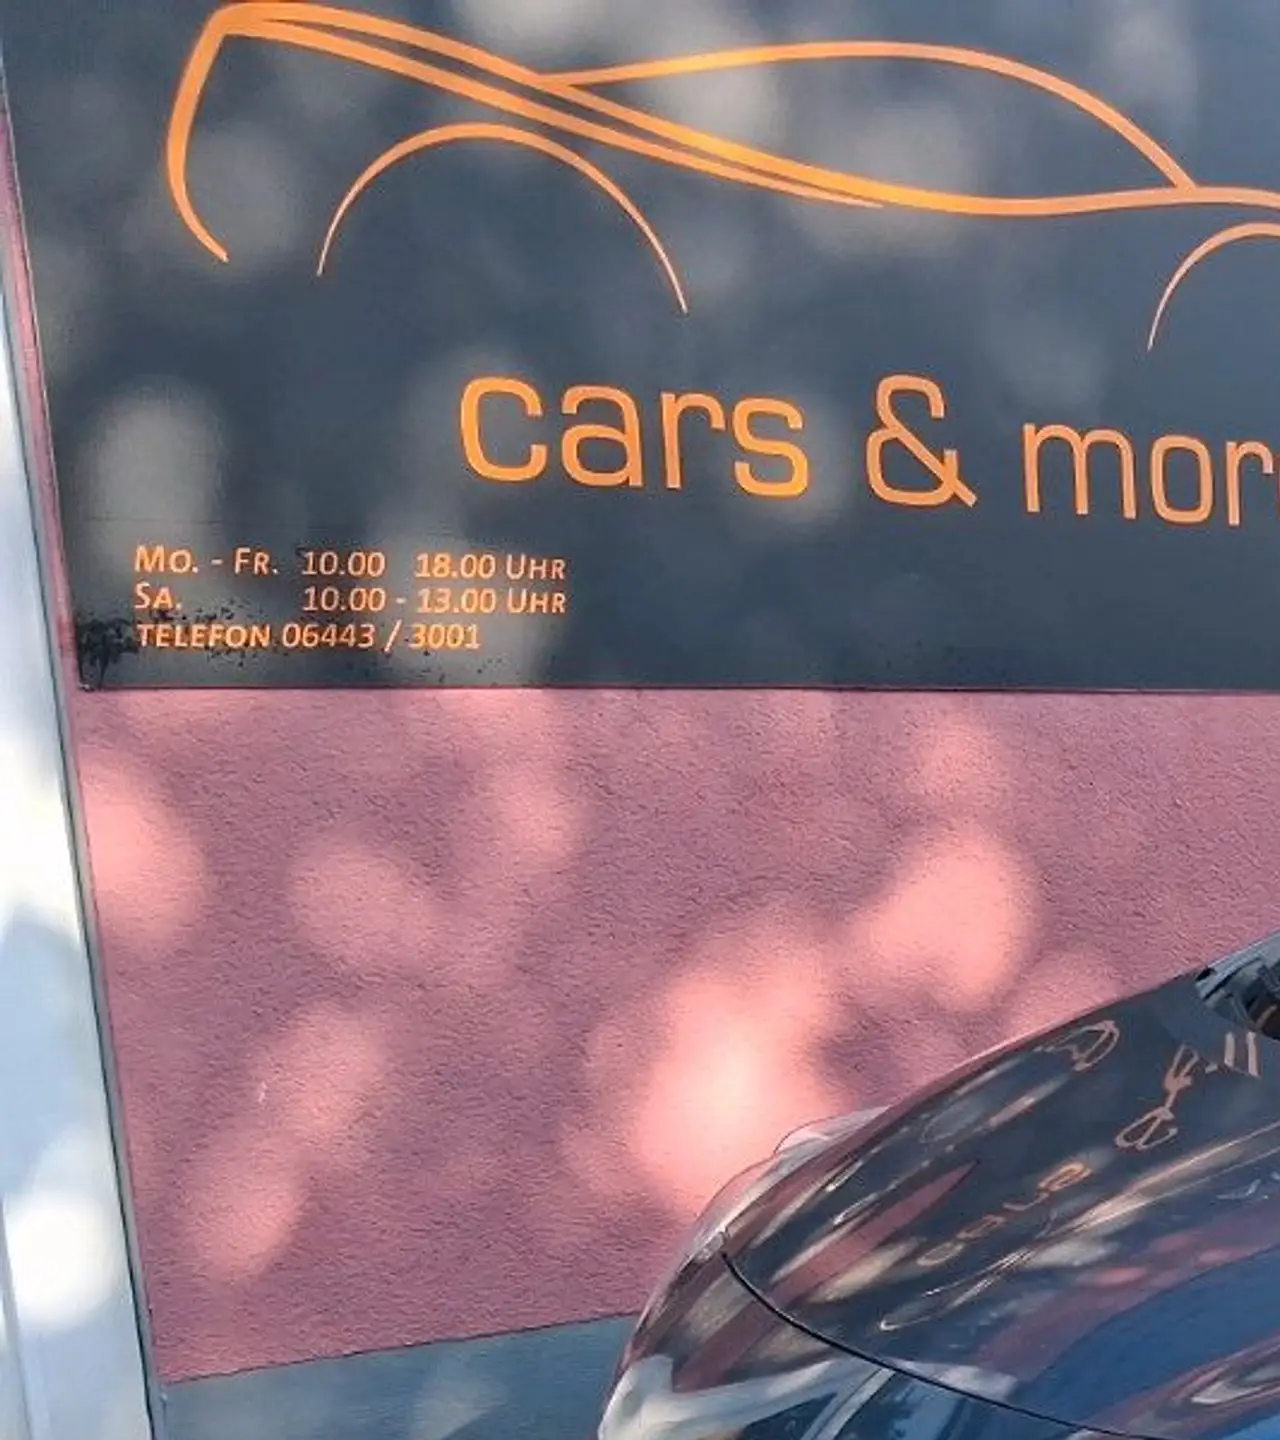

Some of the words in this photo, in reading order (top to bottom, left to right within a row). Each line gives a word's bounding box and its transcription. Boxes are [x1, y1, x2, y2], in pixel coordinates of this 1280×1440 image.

[460, 376, 808, 497] cars
[866, 374, 978, 508] &
[302, 550, 386, 577] 10.00
[415, 552, 496, 579] 18.00
[302, 585, 387, 613] 10.00
[417, 587, 497, 614] 13.00
[136, 623, 271, 649] TELEFON
[281, 622, 376, 649] 06443
[408, 623, 480, 650] 3001
